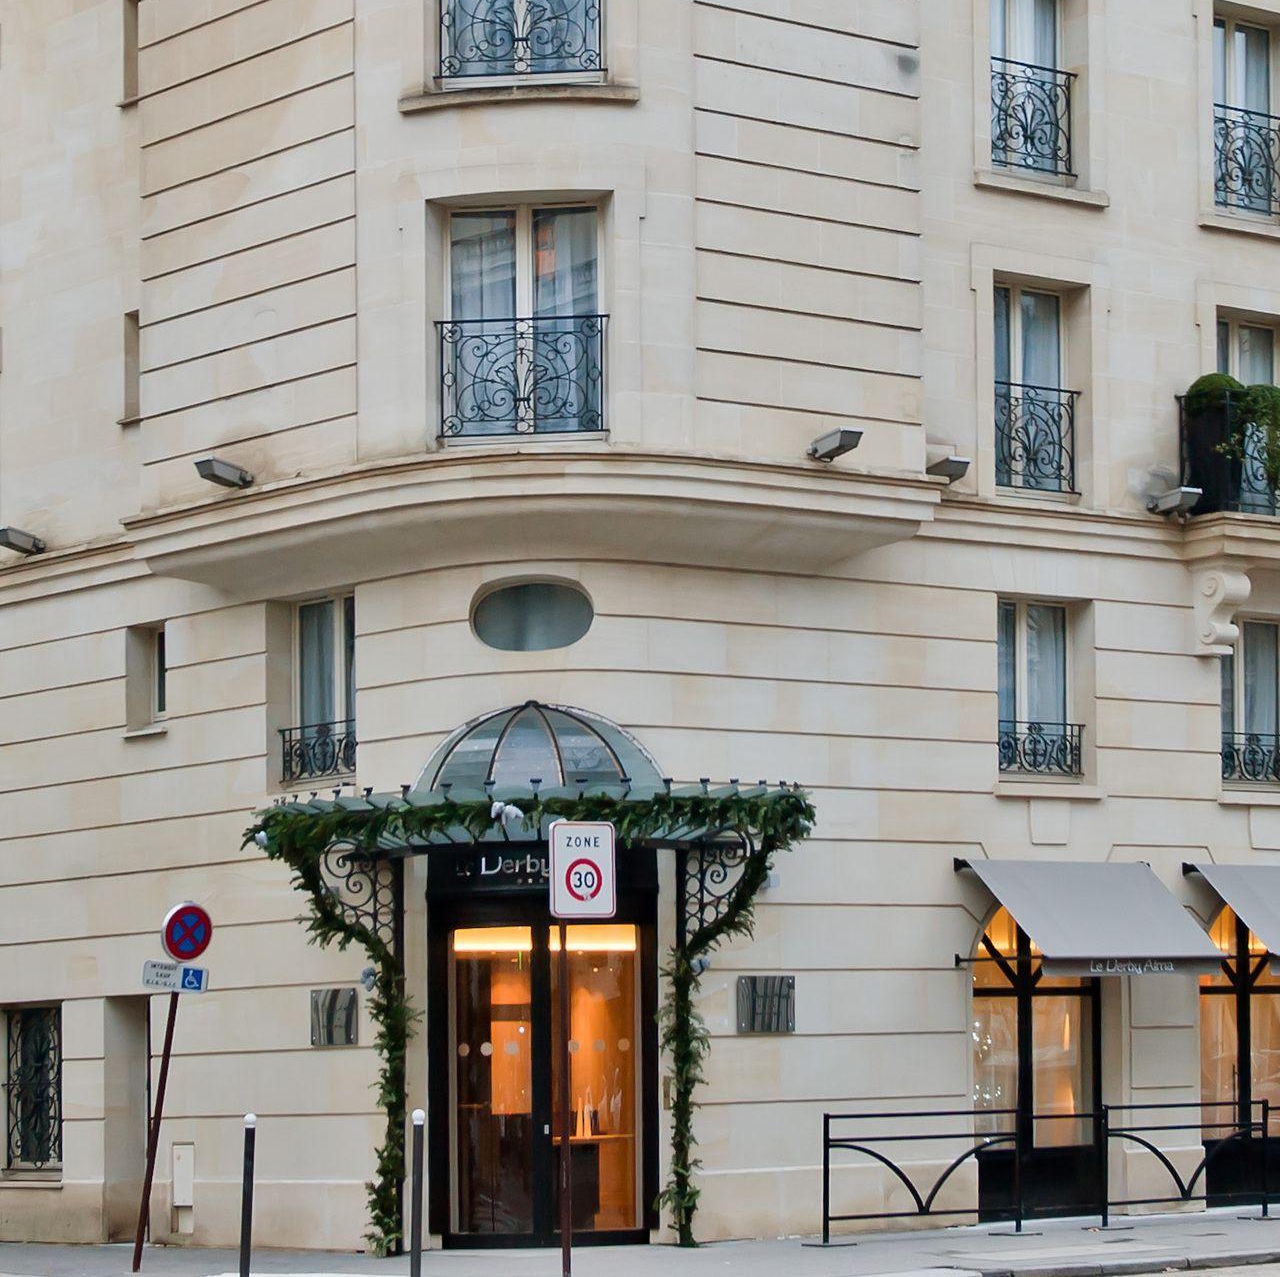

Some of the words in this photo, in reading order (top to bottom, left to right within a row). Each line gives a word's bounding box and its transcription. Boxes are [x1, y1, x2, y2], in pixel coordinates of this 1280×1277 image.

[566, 836, 600, 848] ZONE
[573, 871, 595, 889] 30
[1090, 960, 1103, 972] Le
